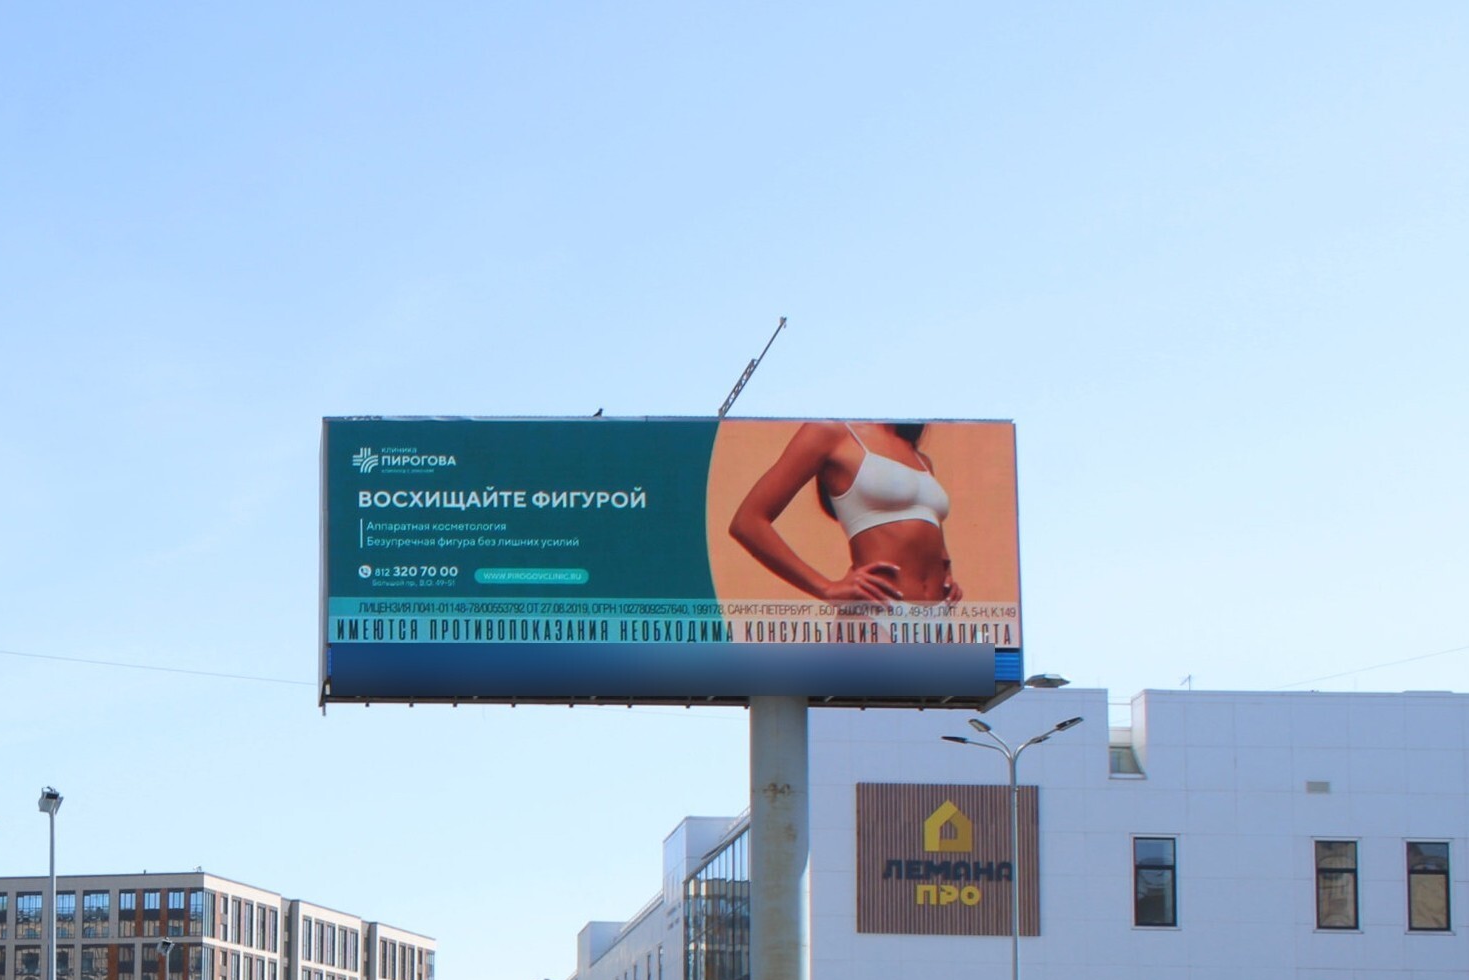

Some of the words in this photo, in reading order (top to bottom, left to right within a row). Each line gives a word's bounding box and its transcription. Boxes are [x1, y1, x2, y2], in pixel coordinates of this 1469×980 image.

[381, 455, 457, 467] ПИРОГОВА
[358, 486, 527, 511] ВОСХИЩАЙТЕ
[531, 486, 647, 509] ФИГУРОЙ
[366, 521, 430, 532] Аппаратная
[432, 522, 507, 531] косметология
[366, 536, 436, 548] Безупречная
[438, 537, 476, 548] фигура
[478, 536, 496, 547] без
[497, 538, 540, 547] лишних
[541, 537, 580, 548] усилий
[374, 568, 391, 577] 812
[393, 566, 417, 577] 320
[420, 566, 436, 577] 70
[439, 566, 458, 577] 00
[358, 602, 410, 614] ЛИЦЕНЗИЯ
[526, 602, 539, 613] ОТ
[540, 603, 590, 614] 27.08.2019,
[591, 604, 617, 614] ОГРН
[337, 618, 418, 641] ИМЕЮТСЯ
[430, 618, 608, 642] ПРОТИВОПОКАЗАНИЯ
[620, 620, 734, 643] НЕОБХОДИМА
[745, 620, 878, 643] КОНСУЛЬТАЦИЯ
[890, 622, 1011, 645] СПЕЦИАЛИСТА
[882, 859, 1013, 882] ЛЕМАНА
[916, 884, 982, 906] ПРО
